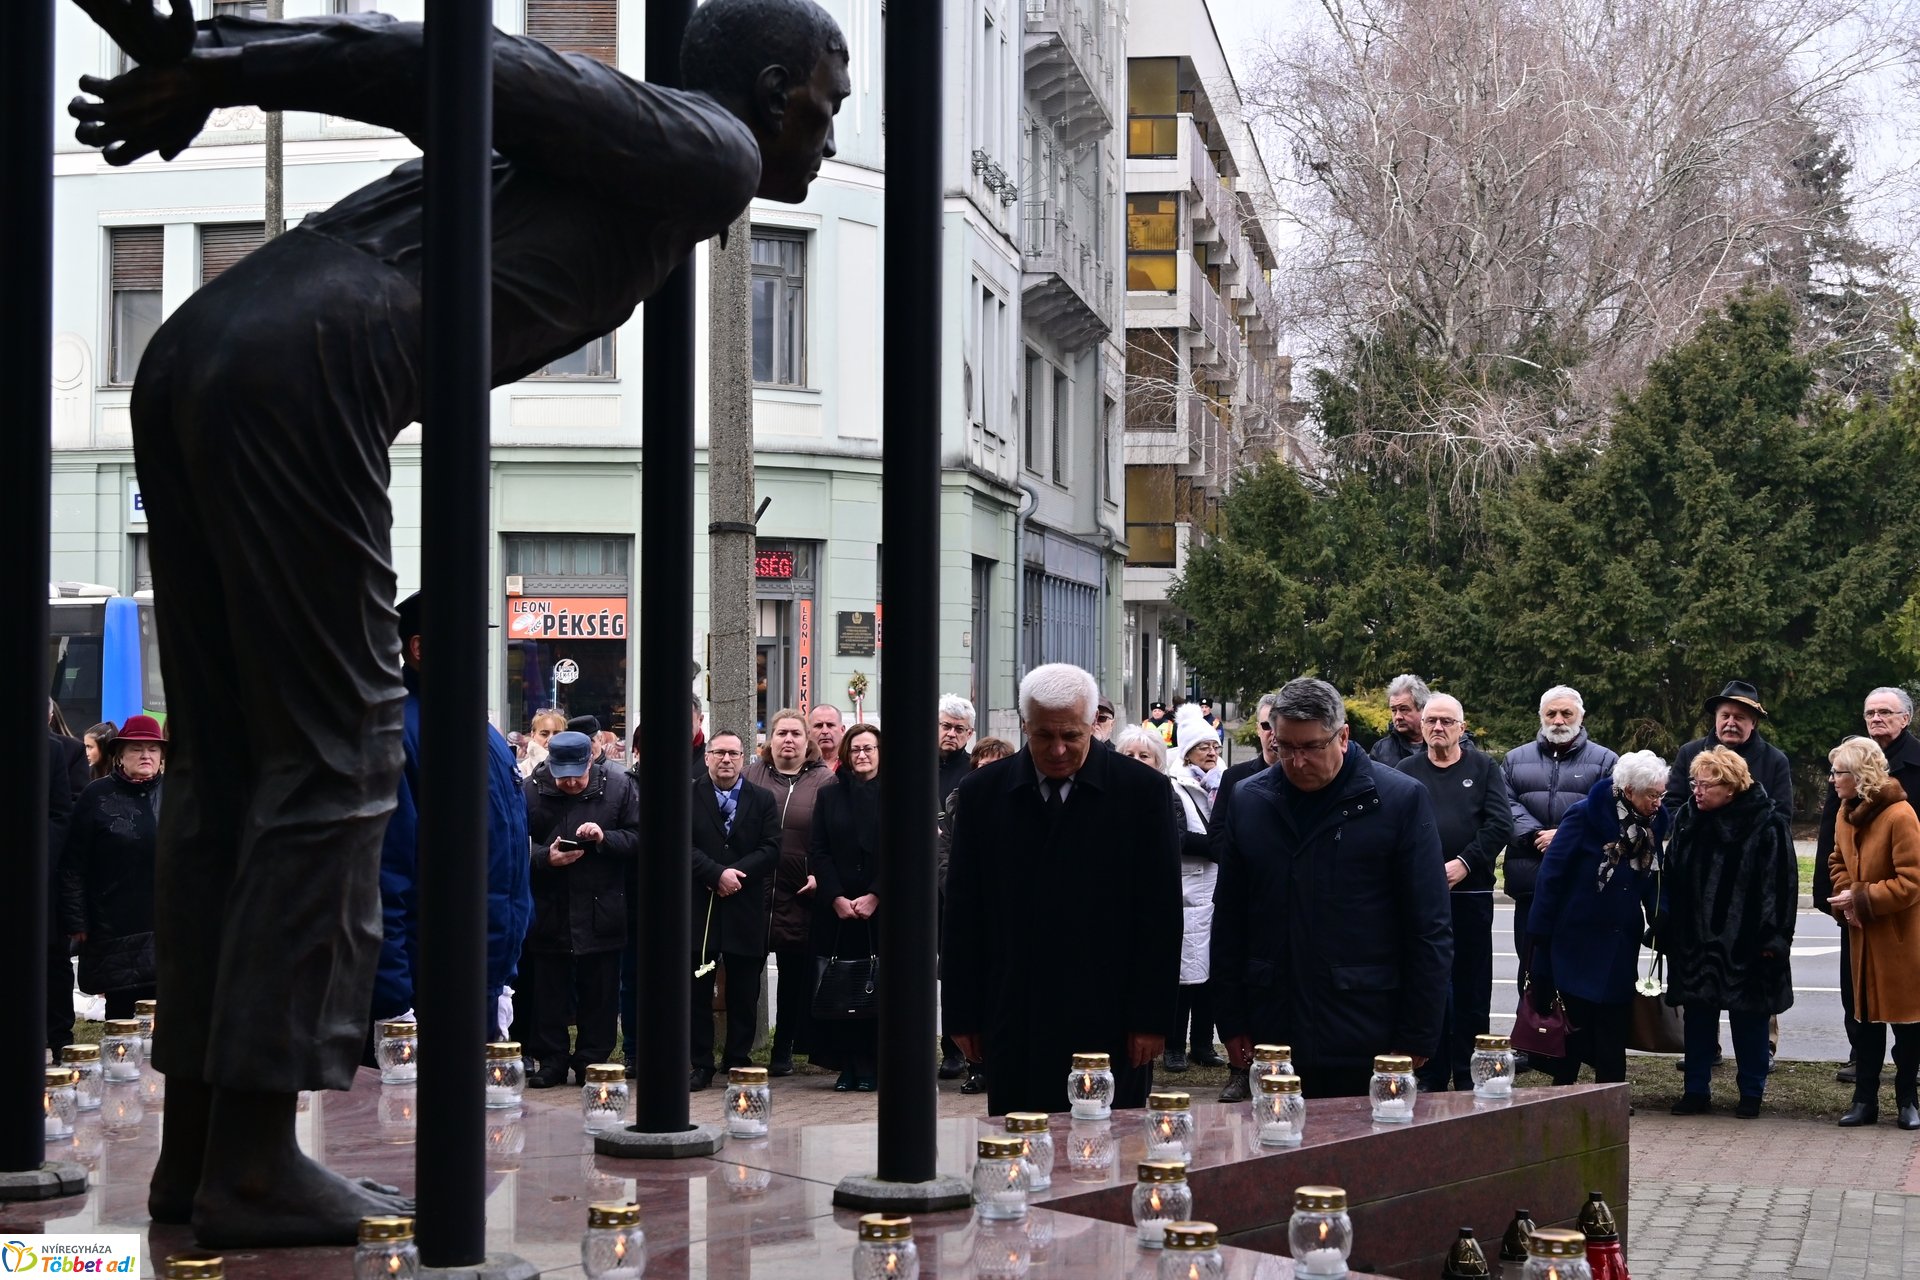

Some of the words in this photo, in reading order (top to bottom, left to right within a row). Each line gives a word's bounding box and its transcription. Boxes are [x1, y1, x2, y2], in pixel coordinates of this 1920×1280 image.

[514, 601, 551, 613] LEONI
[543, 609, 624, 636] PÉKSÉG
[800, 656, 808, 717] PÉKS
